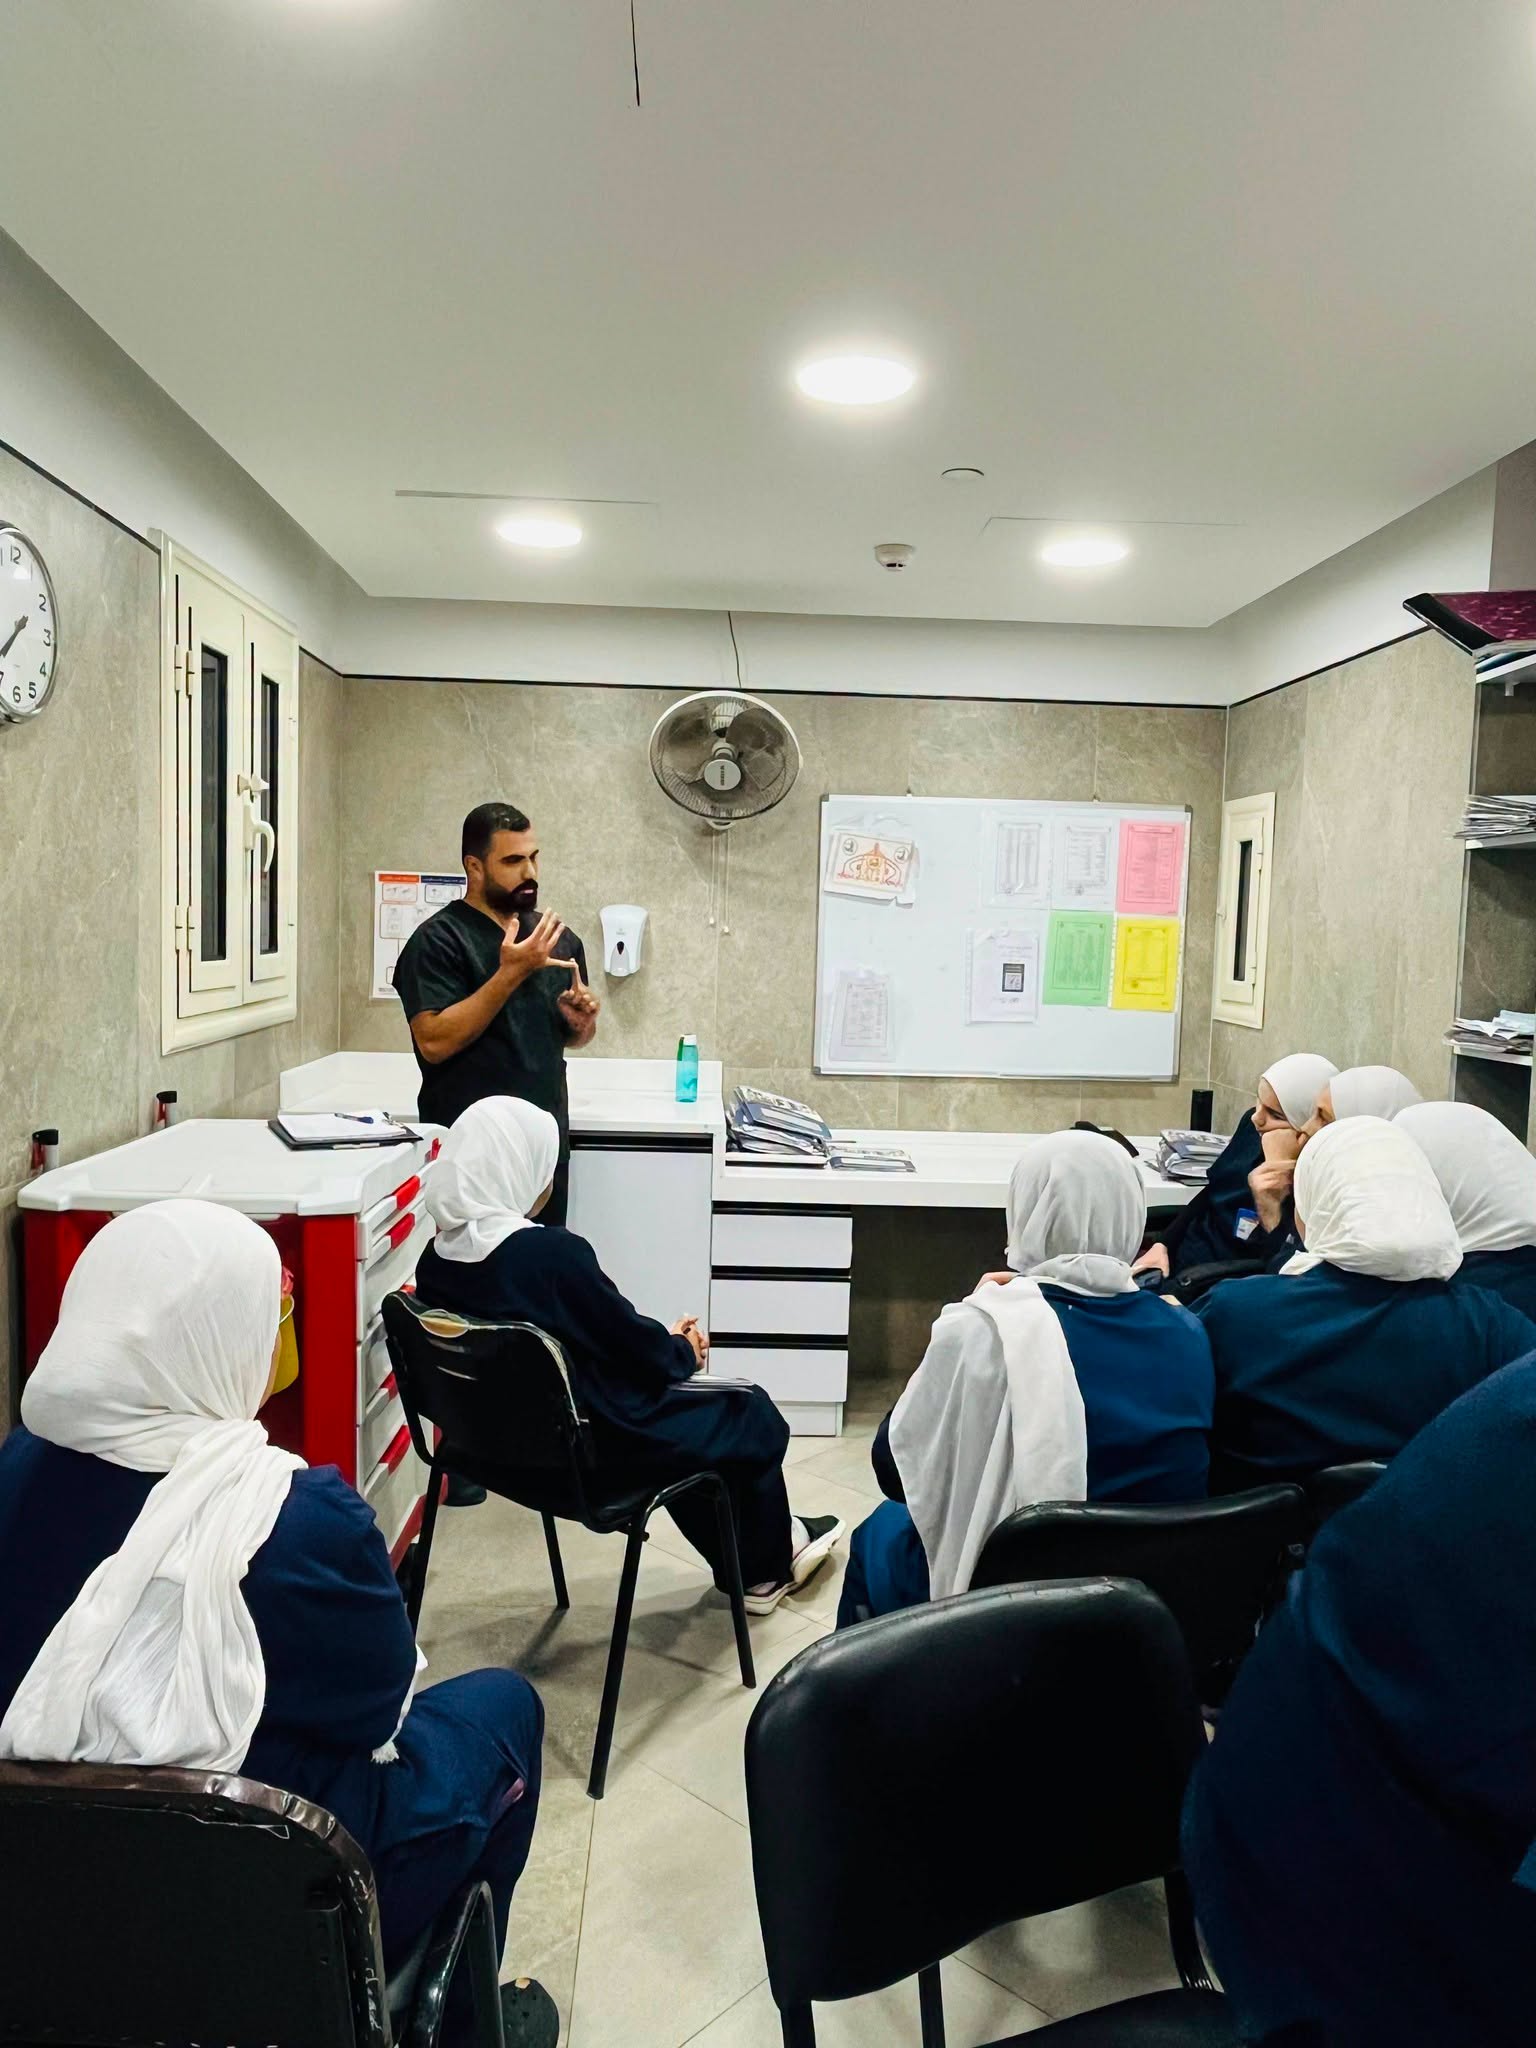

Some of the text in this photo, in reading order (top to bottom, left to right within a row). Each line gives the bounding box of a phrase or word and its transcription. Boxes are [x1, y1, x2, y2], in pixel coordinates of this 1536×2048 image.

[10, 544, 21, 565] 12
[39, 593, 46, 612] 2
[43, 628, 51, 647] 3
[39, 661, 47, 678] 4
[12, 685, 21, 704] 6
[28, 681, 37, 699] 5
